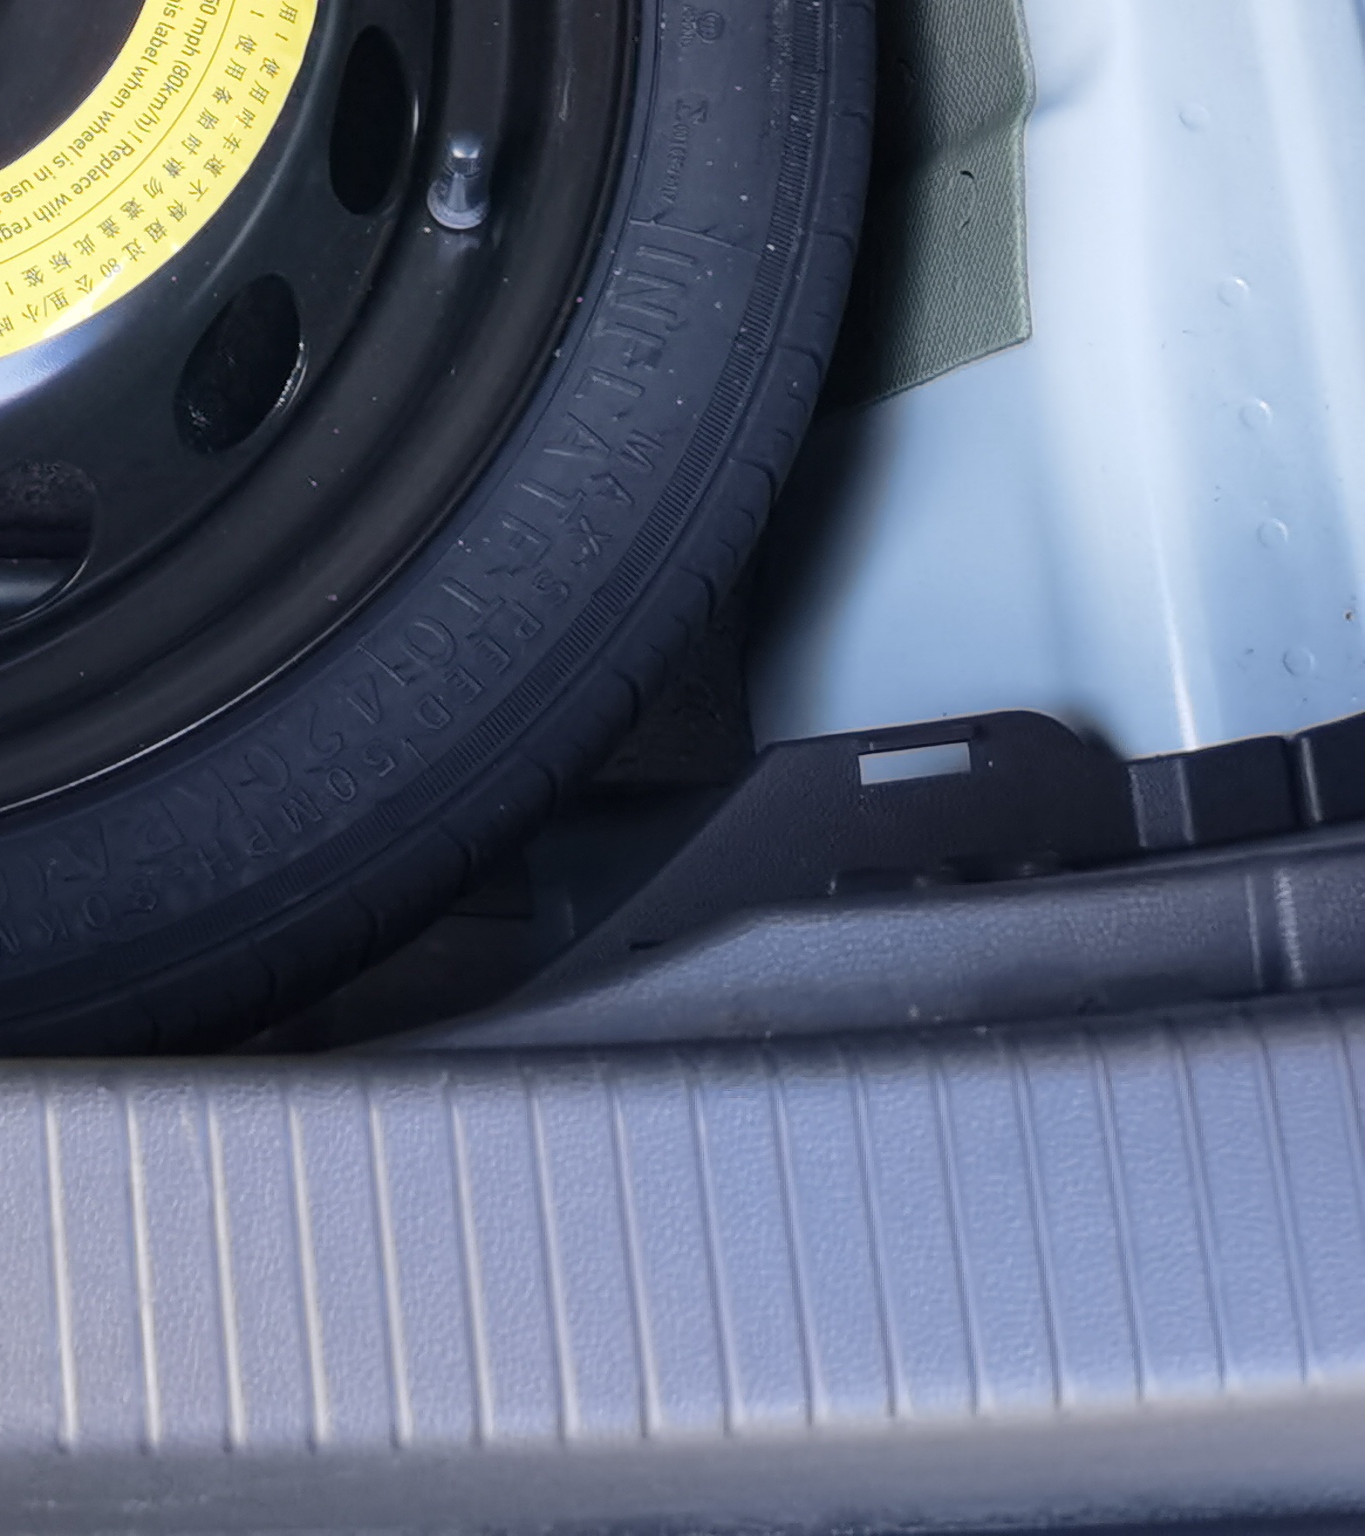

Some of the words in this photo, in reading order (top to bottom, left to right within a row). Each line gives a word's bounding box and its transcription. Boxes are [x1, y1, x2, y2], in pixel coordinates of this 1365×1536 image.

[140, 20, 176, 66] label
[180, 16, 209, 58] mph
[109, 65, 150, 110] when
[133, 59, 193, 134] (80km/h)
[67, 109, 116, 159] wheel
[32, 164, 57, 183] in
[51, 150, 75, 169] is
[69, 138, 136, 196] Replace
[0, 178, 35, 205] use
[31, 192, 73, 224] with
[482, 237, 700, 570] INFLATE
[565, 427, 668, 557] MAX
[387, 561, 507, 678] TO
[405, 564, 578, 739] SPEED
